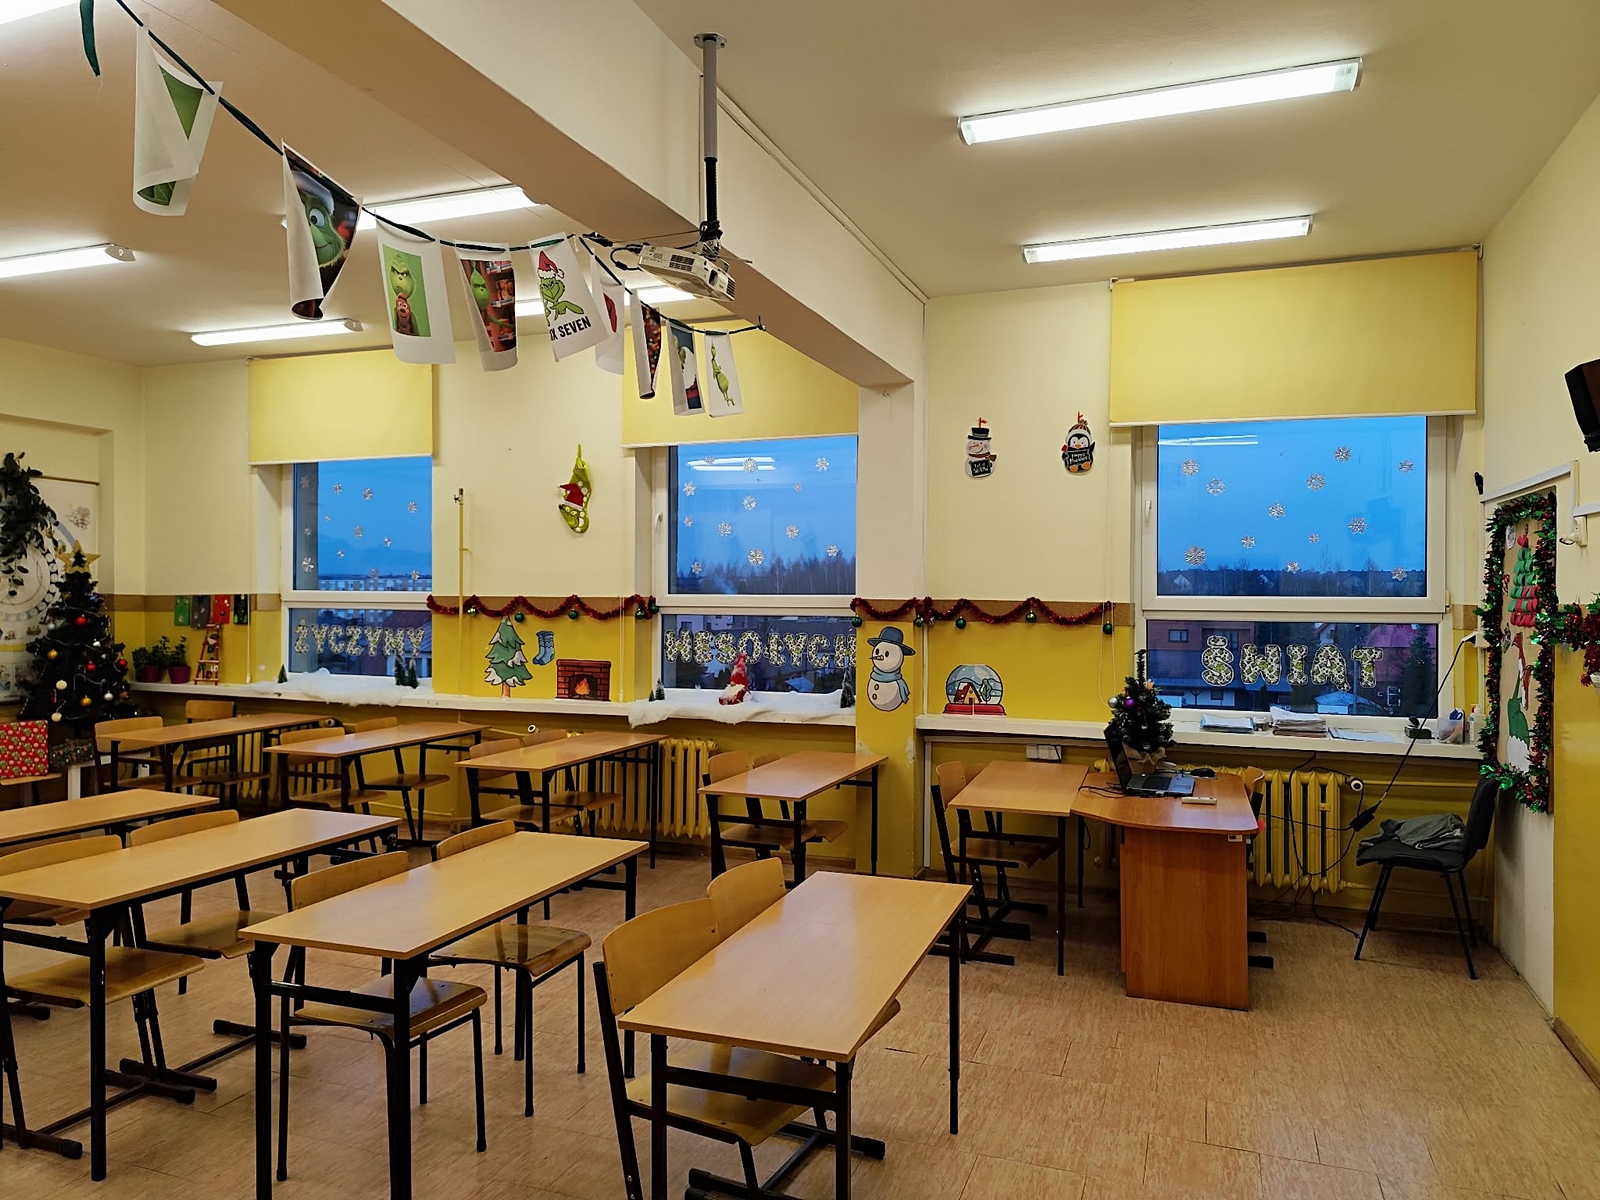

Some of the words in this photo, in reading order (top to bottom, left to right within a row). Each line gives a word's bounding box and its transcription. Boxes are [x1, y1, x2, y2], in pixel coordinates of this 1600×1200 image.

[557, 315, 592, 338] SEVEN
[294, 618, 425, 657] ŻYCZYMY
[664, 628, 857, 668] WESOŁYCH
[1201, 635, 1384, 692] ŚWIĄT
